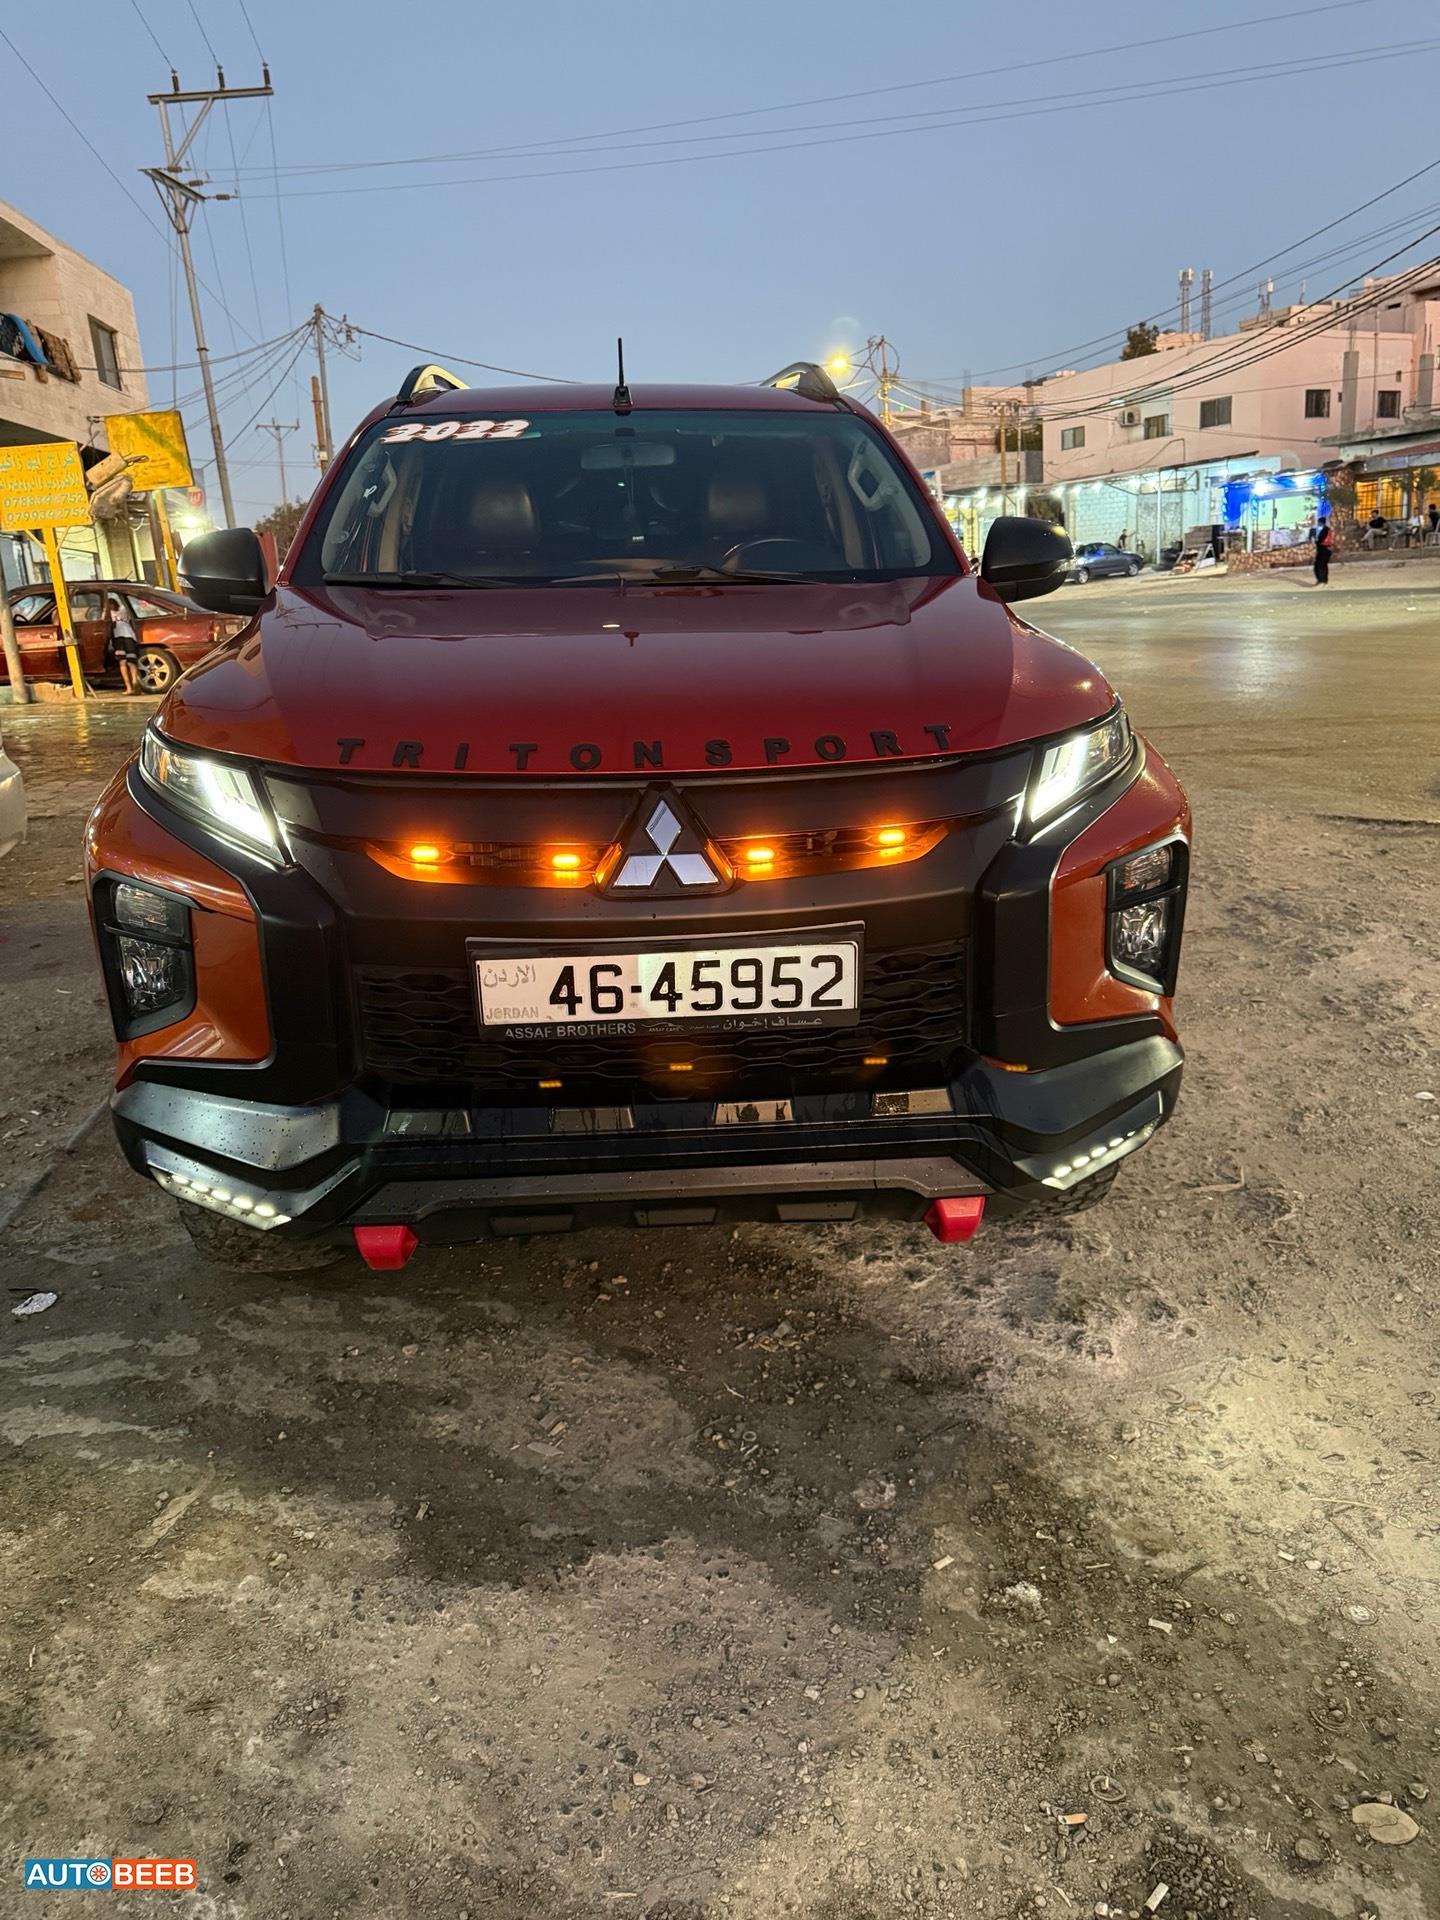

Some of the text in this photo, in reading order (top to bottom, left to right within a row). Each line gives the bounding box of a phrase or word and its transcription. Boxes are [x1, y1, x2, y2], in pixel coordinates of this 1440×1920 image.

[380, 419, 531, 444] 2022
[704, 722, 954, 765] SPORT
[549, 955, 843, 1016] 46-45952
[486, 1006, 539, 1020] JORDAN
[505, 1022, 637, 1039] ASSAF BROTHERS
